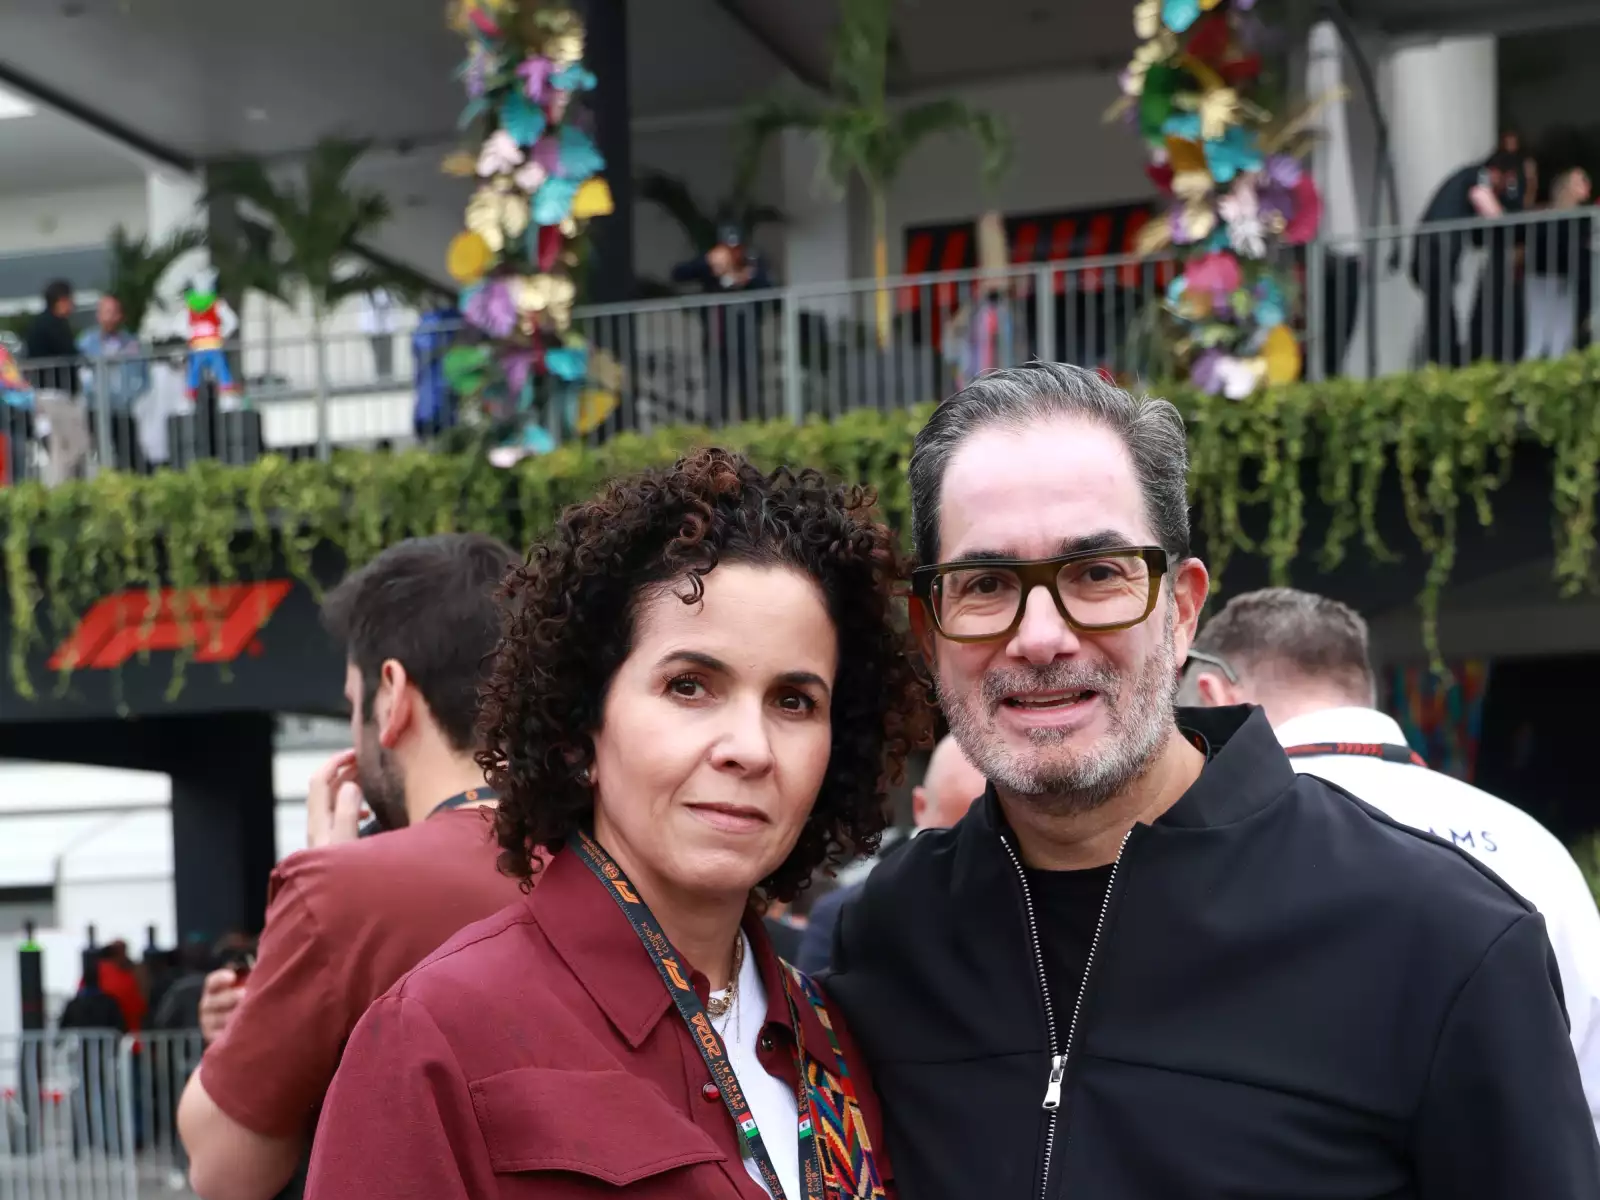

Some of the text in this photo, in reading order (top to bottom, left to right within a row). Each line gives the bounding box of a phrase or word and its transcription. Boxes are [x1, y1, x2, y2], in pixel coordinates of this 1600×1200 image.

[641, 922, 664, 957] PADDOCK
[655, 933, 670, 954] CLUB
[691, 1011, 722, 1060] 2024
[713, 1062, 741, 1110] MEXICO CITY
[719, 1059, 746, 1109] SUNDAY
[805, 1158, 813, 1193] PADDOCK
[811, 1172, 820, 1192] CLUB
